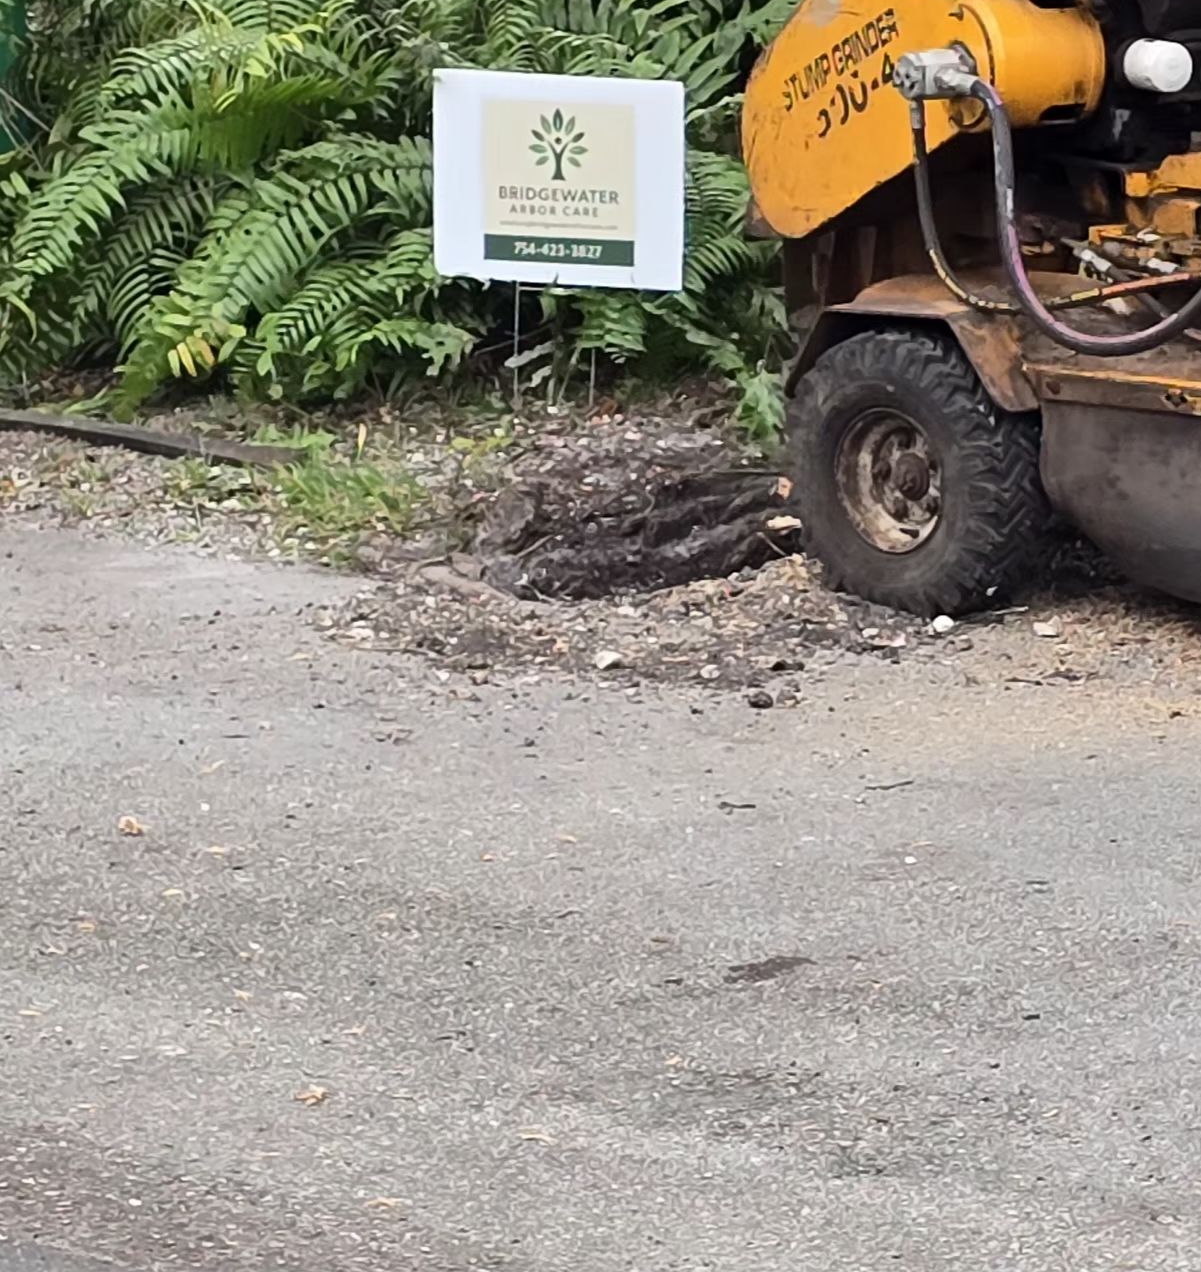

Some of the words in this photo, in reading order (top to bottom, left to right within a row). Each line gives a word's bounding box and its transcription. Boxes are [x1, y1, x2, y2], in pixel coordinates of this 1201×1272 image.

[782, 52, 831, 112] STUMP
[831, 7, 900, 77] GRINDER
[498, 185, 620, 205] BRIDGEWATER
[509, 203, 557, 216] ARBOR
[562, 205, 599, 218] CARE
